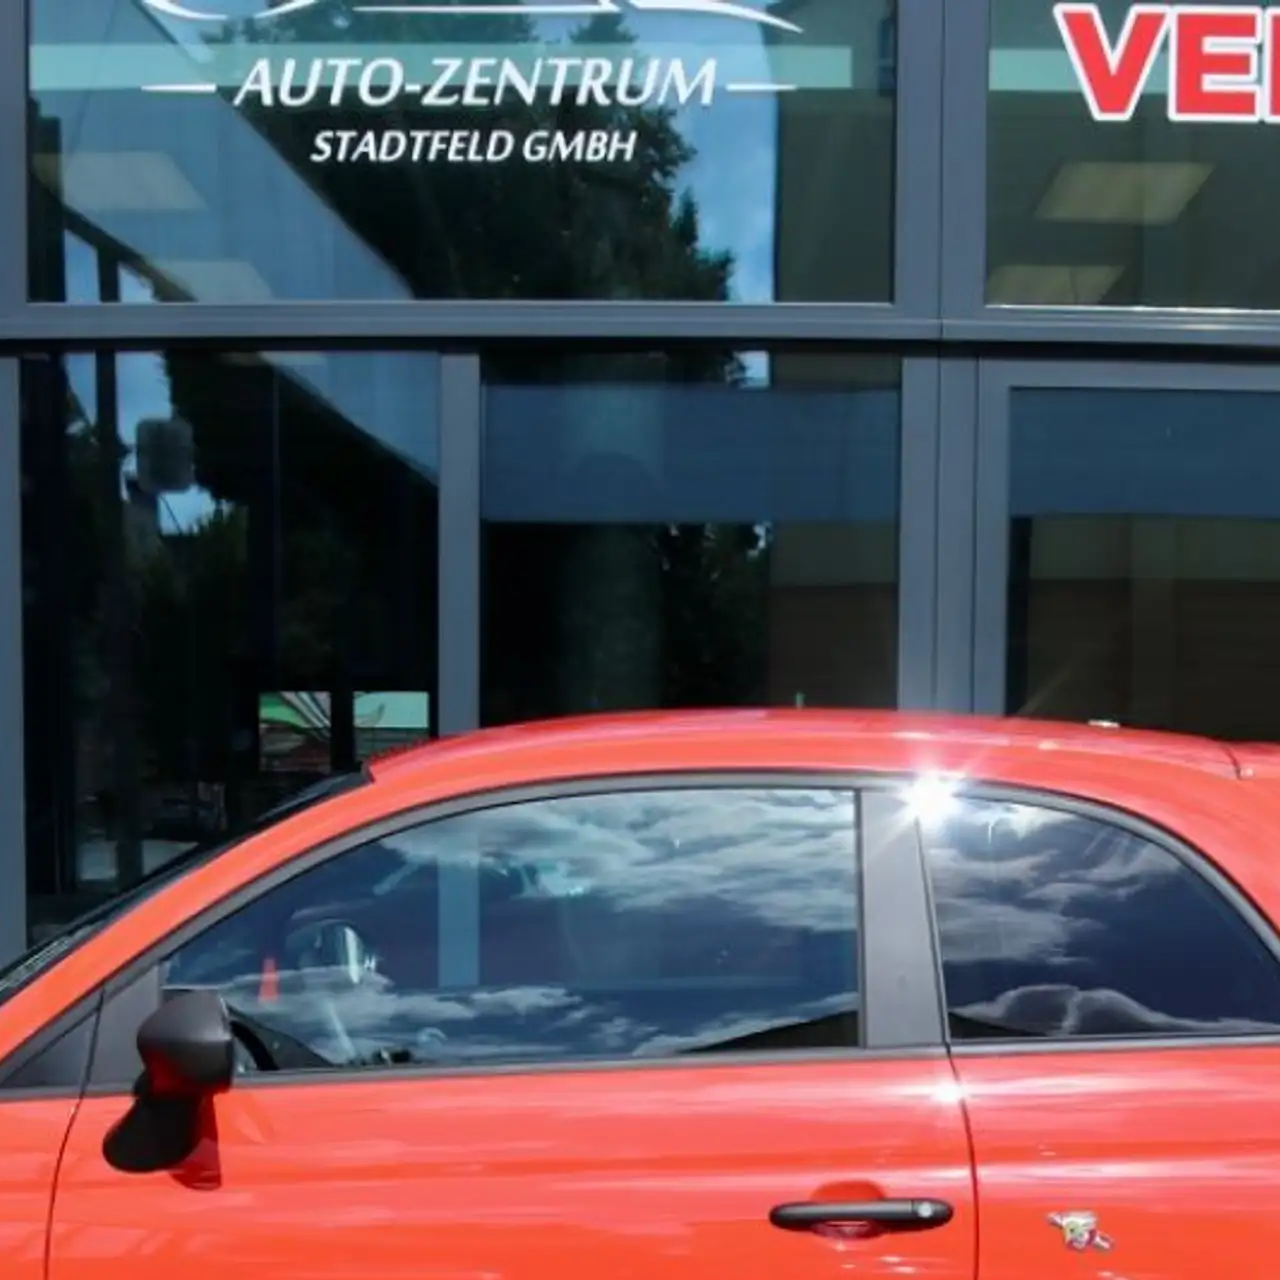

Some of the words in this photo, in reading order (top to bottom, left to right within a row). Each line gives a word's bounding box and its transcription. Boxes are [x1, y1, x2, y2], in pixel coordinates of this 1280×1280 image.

[233, 58, 717, 108] AUTO-ZENTRUM
[310, 130, 515, 162] STADTFELD
[523, 131, 637, 162] GMBH
